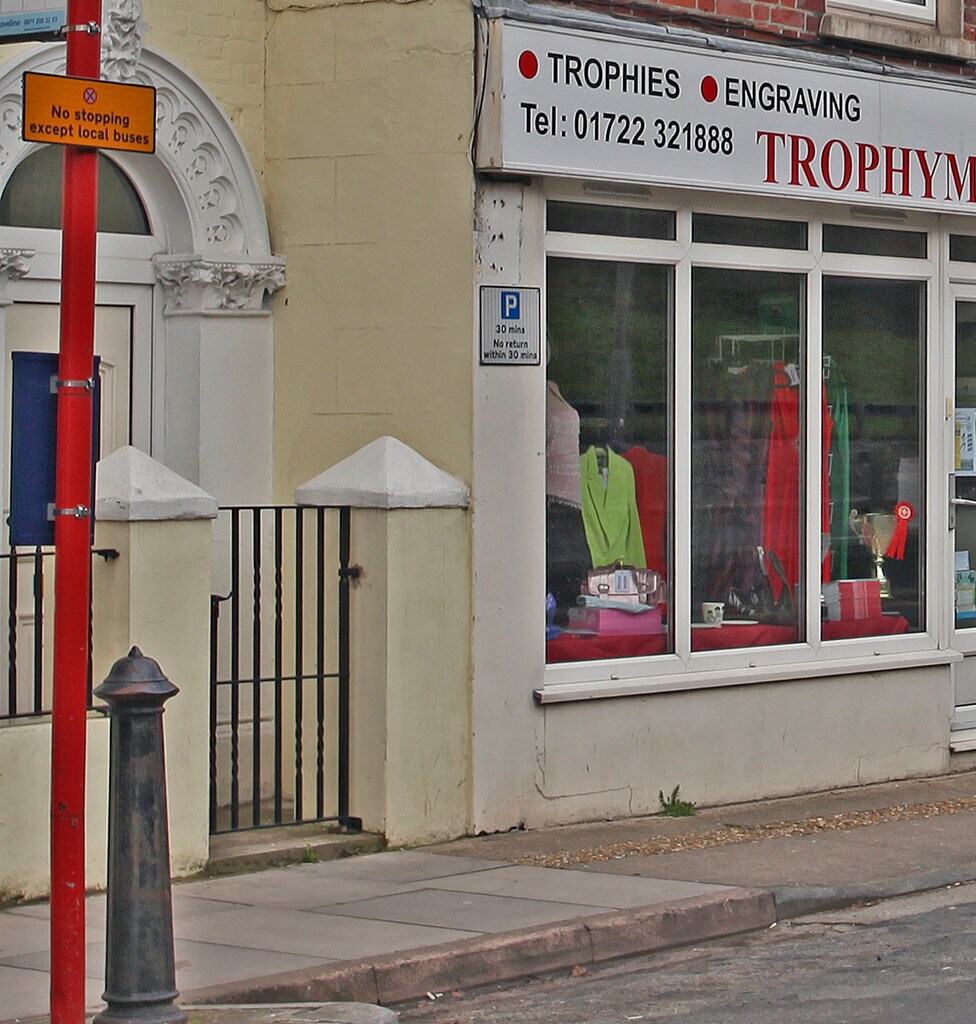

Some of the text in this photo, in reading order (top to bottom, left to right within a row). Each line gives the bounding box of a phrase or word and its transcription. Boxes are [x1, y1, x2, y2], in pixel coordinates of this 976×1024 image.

[548, 52, 862, 122] TROPHIES ENGRAVING
[51, 105, 130, 128] No stopping
[29, 123, 149, 145] except local buses
[520, 102, 734, 156] Tel: 01722 321888
[506, 294, 517, 317] P
[496, 324, 525, 334] 30 mins
[483, 350, 537, 359] within 30 mins
[494, 339, 528, 348] No return
